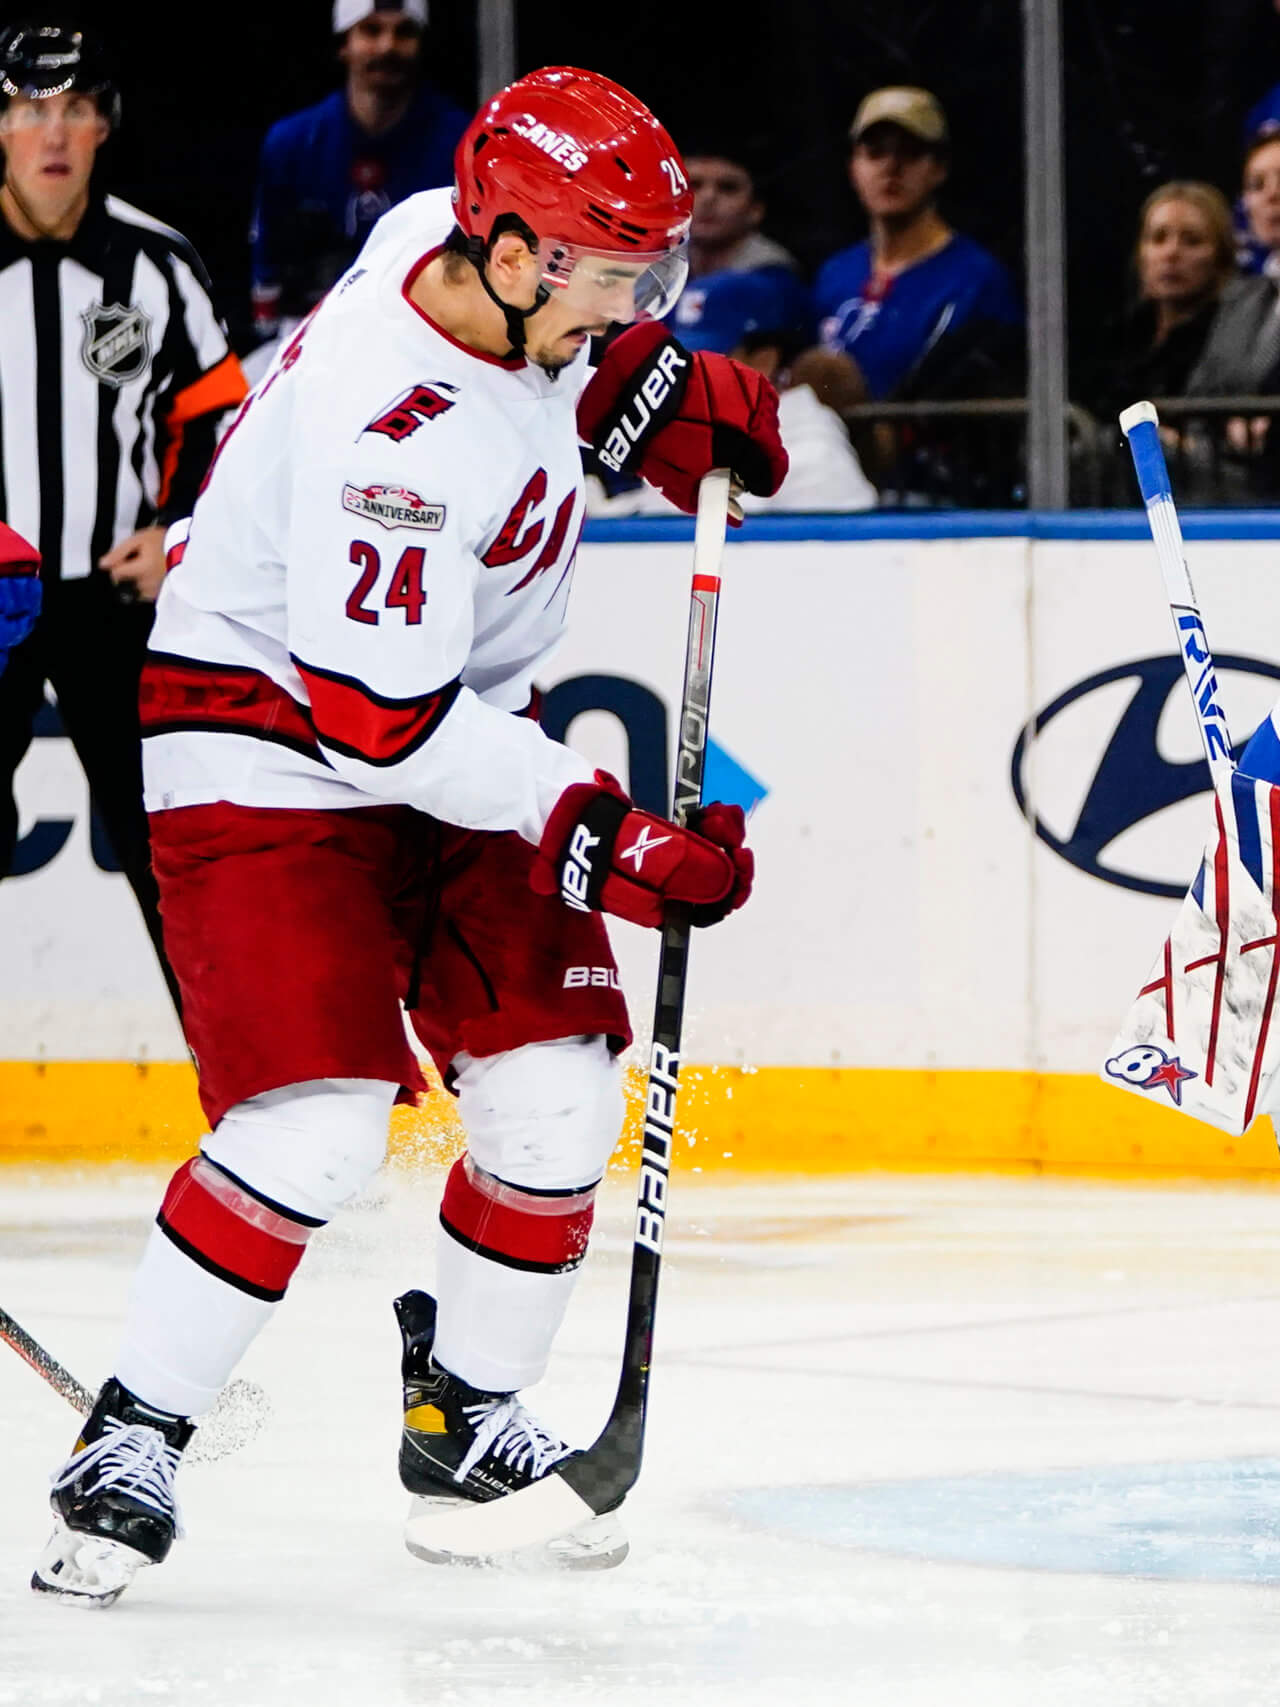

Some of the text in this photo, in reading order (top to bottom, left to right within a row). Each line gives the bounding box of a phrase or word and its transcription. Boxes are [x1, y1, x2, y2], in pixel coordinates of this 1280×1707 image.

[512, 113, 588, 172] CANES
[660, 157, 688, 196] 24
[363, 498, 441, 525] ANNIVERSARY
[346, 540, 427, 626] 24
